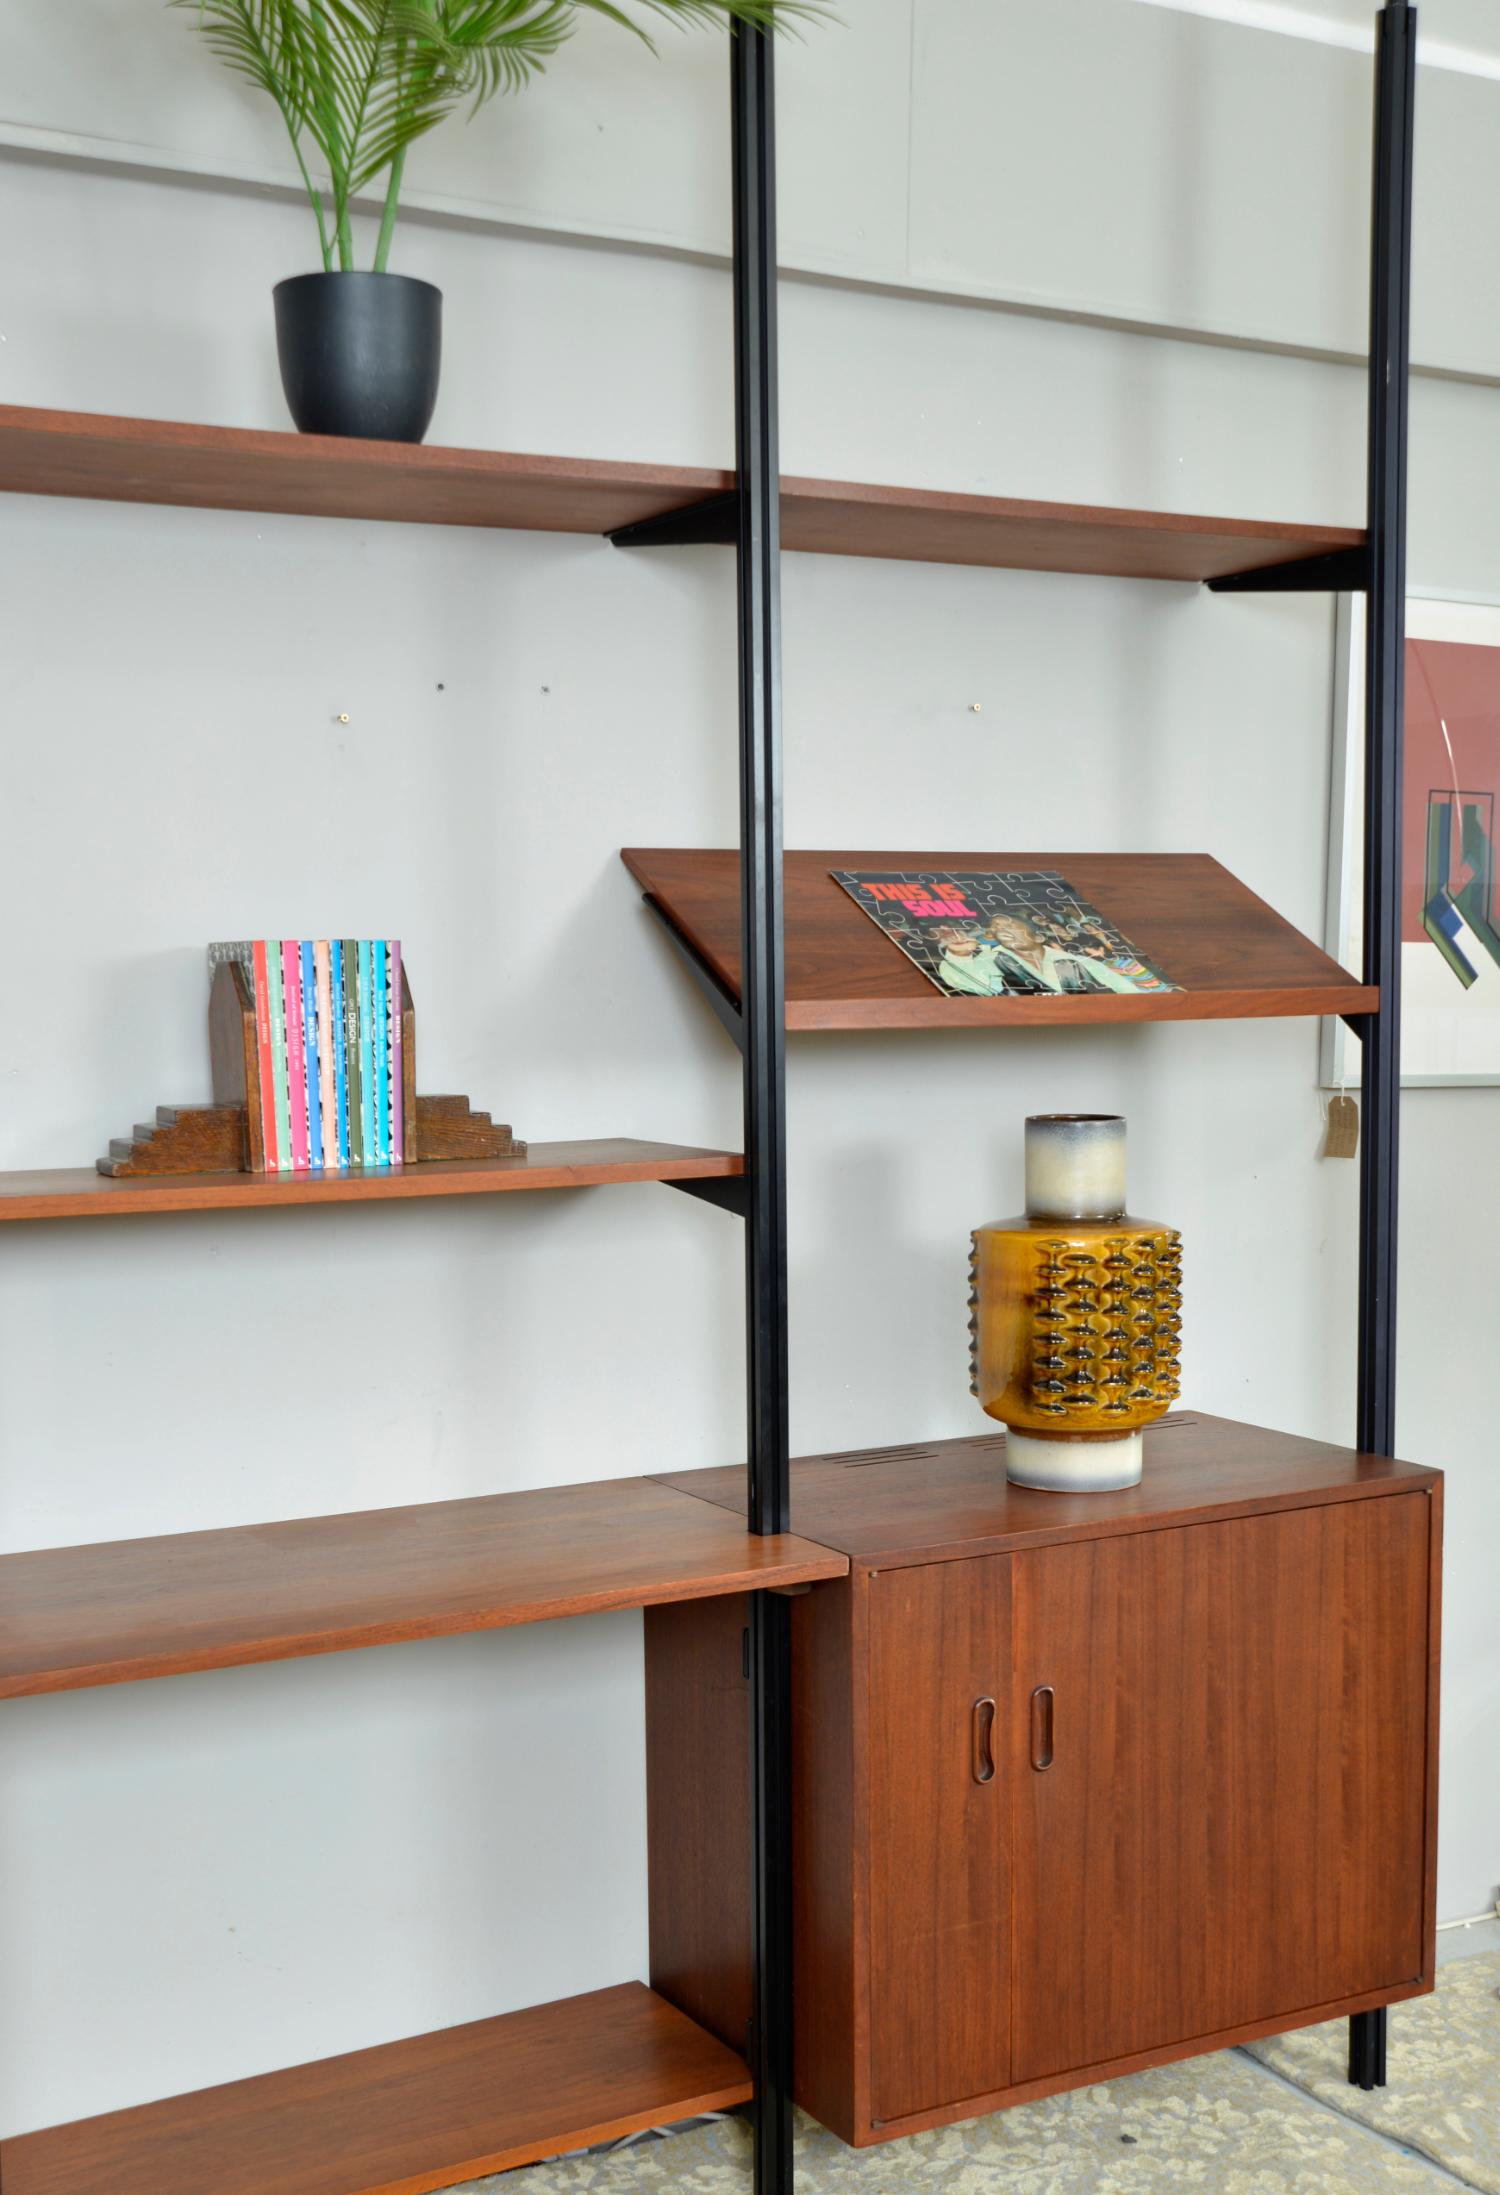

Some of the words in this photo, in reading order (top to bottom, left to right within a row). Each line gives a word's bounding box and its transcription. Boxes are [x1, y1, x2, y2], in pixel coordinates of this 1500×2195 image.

[860, 882, 933, 901] THIS
[928, 882, 967, 901] IS
[901, 899, 977, 918] SOUL
[308, 1016, 316, 1047] DESIGN
[348, 1012, 357, 1044] DESIGN
